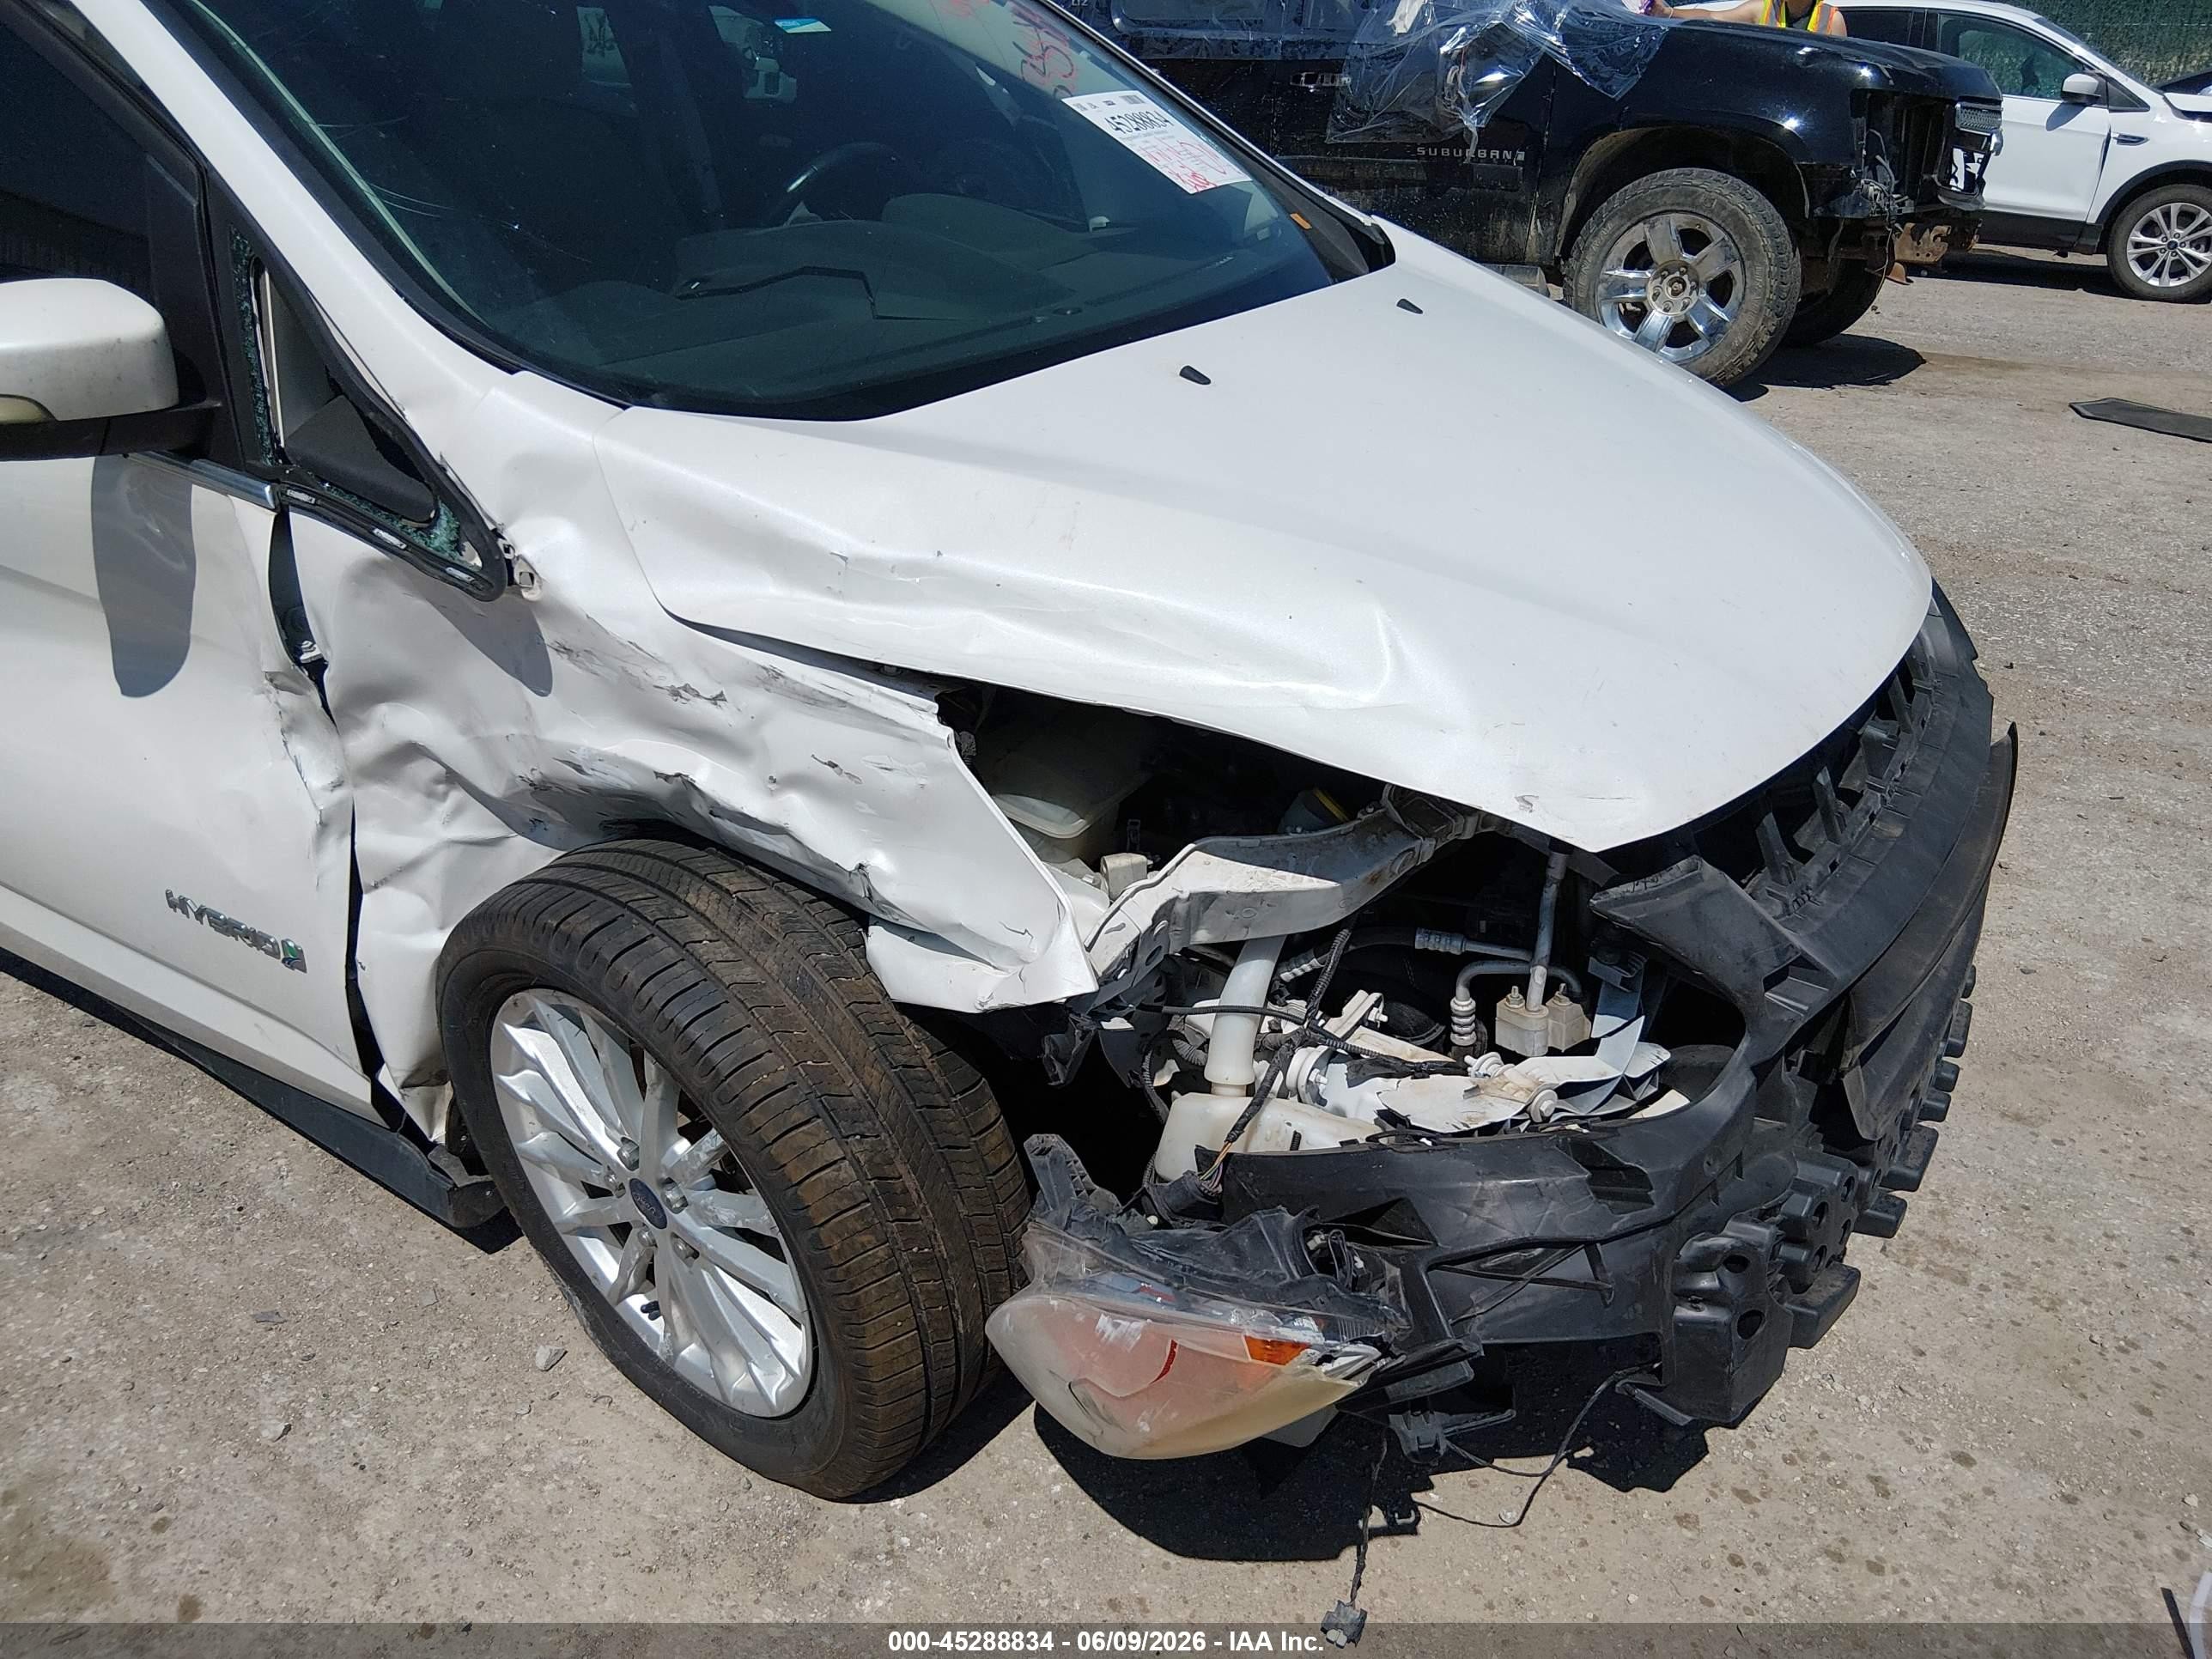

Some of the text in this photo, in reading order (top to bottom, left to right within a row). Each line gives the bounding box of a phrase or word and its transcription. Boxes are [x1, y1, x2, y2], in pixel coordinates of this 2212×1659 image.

[1104, 109, 1176, 136] 45288834
[1416, 146, 1512, 160] SUBURBAN
[165, 889, 282, 960] HYBRID
